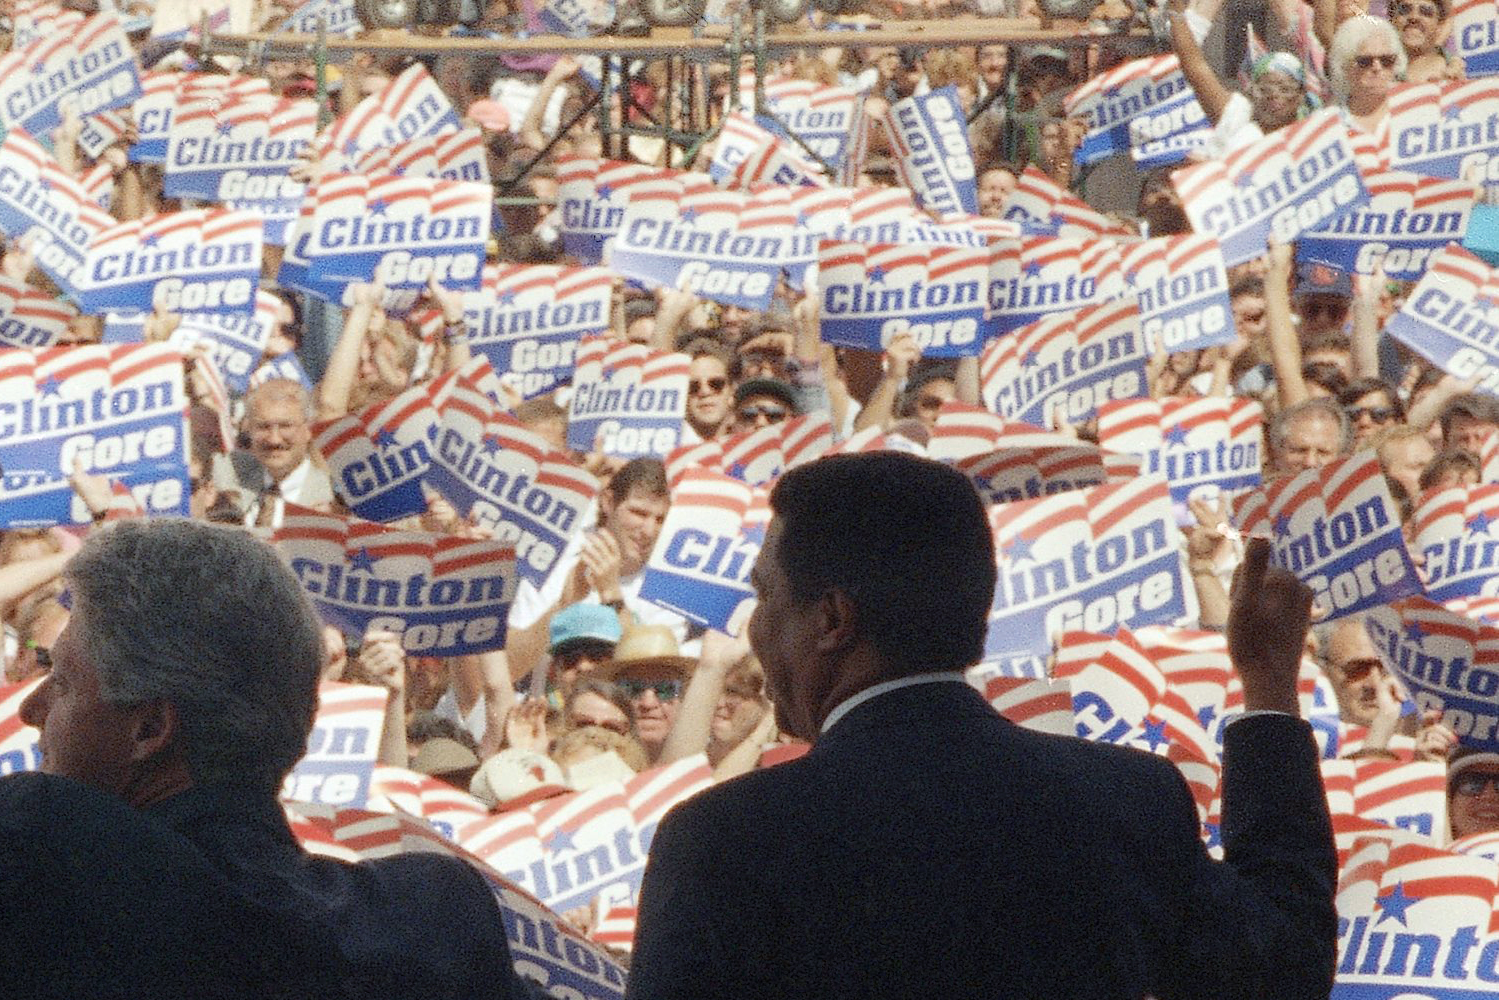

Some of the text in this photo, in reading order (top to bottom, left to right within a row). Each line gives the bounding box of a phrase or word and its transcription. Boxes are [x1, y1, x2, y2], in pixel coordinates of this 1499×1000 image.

[7, 42, 122, 117] Clinton
[1401, 119, 1499, 157] Clint
[1205, 140, 1345, 233] Clinton
[1276, 177, 1358, 232] Gore
[322, 210, 481, 248] Clinton
[565, 198, 623, 228] Clin
[1335, 211, 1460, 234] linton
[628, 218, 782, 258] Clinton
[93, 243, 252, 282] Clinton
[382, 251, 479, 286] Gore
[680, 262, 772, 295] Gore
[154, 279, 250, 310] Gore
[825, 279, 979, 313] Clinton
[989, 270, 1098, 310] Clinto
[1138, 265, 1219, 312] nton
[464, 298, 599, 337] Clinton
[1415, 286, 1499, 345] Clin
[511, 339, 579, 373] Gor
[996, 330, 1134, 412] Clinton
[574, 382, 679, 415] Clinton
[1044, 369, 1140, 428] Gore
[61, 425, 177, 473] Gore
[600, 421, 679, 455] Gore
[341, 438, 432, 499] Clin
[440, 426, 579, 534] Clinton
[1149, 441, 1259, 480] linton
[1270, 493, 1388, 572] inton
[1011, 519, 1166, 603] inton
[1423, 540, 1499, 583] Clin
[291, 556, 506, 609] Clinton
[1045, 571, 1174, 635] Gore
[1365, 615, 1499, 696] Clinto
